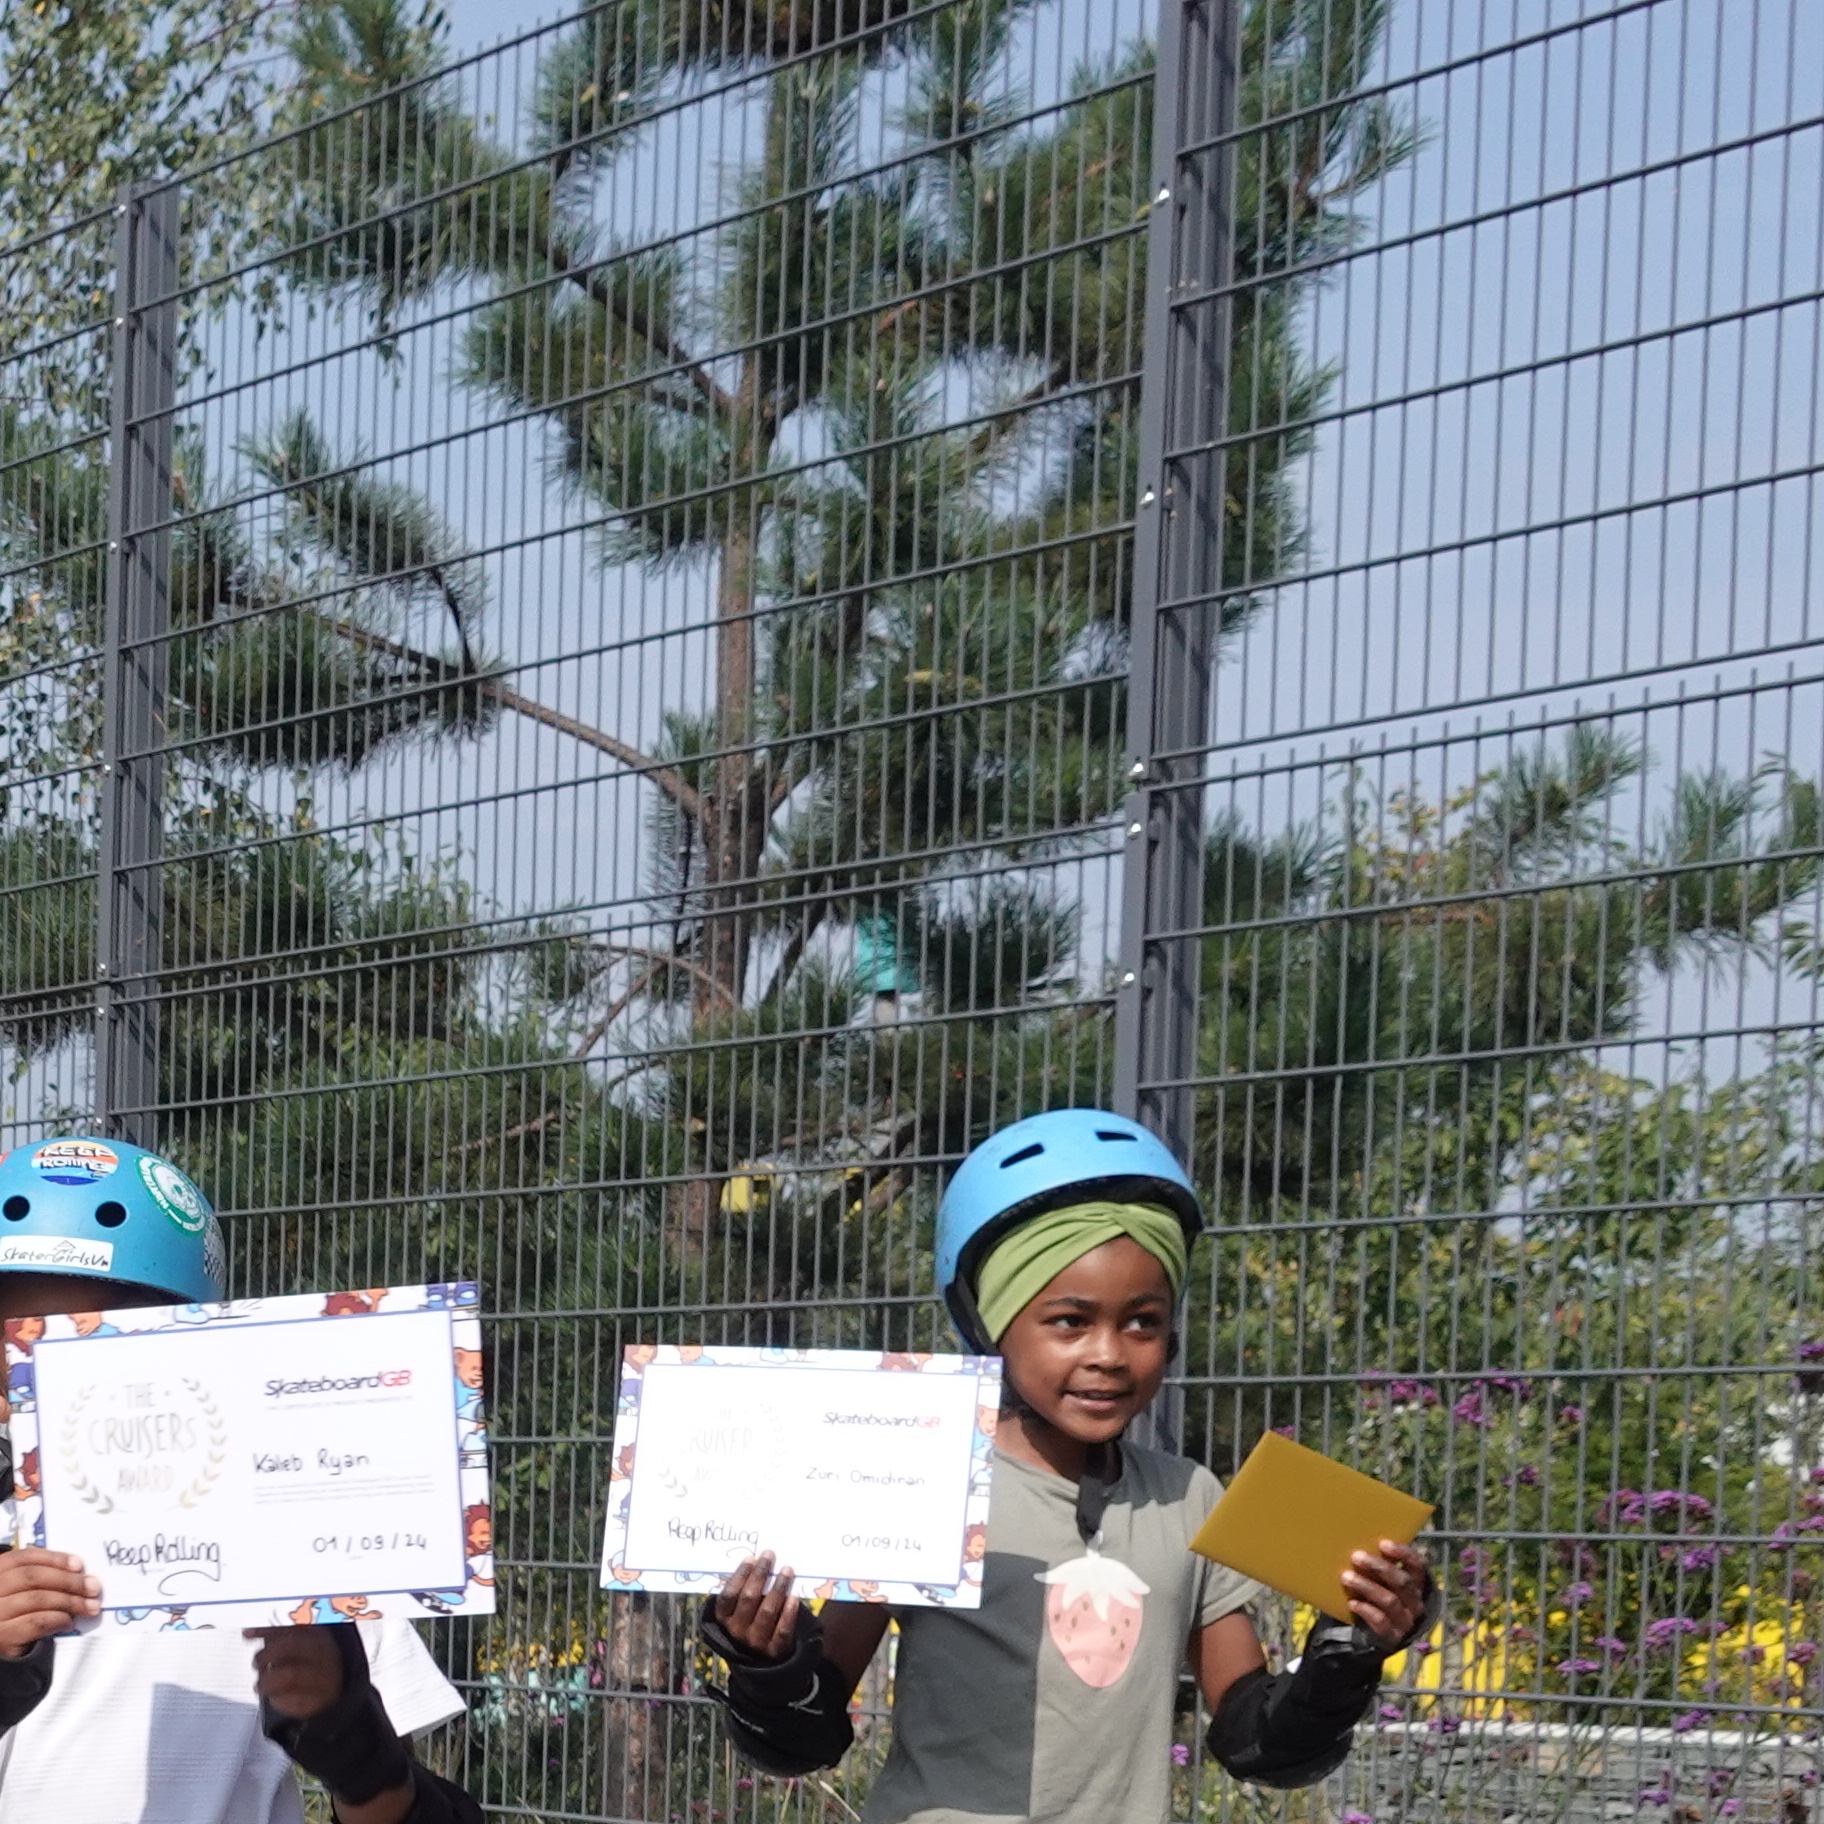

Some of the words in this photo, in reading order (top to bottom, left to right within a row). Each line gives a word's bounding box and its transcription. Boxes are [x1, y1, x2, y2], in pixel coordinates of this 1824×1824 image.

[264, 1370, 412, 1399] SkateboardGB
[88, 1413, 198, 1459] CRUISERS
[317, 1448, 370, 1476] Ryan
[805, 1466, 840, 1482] Zuri
